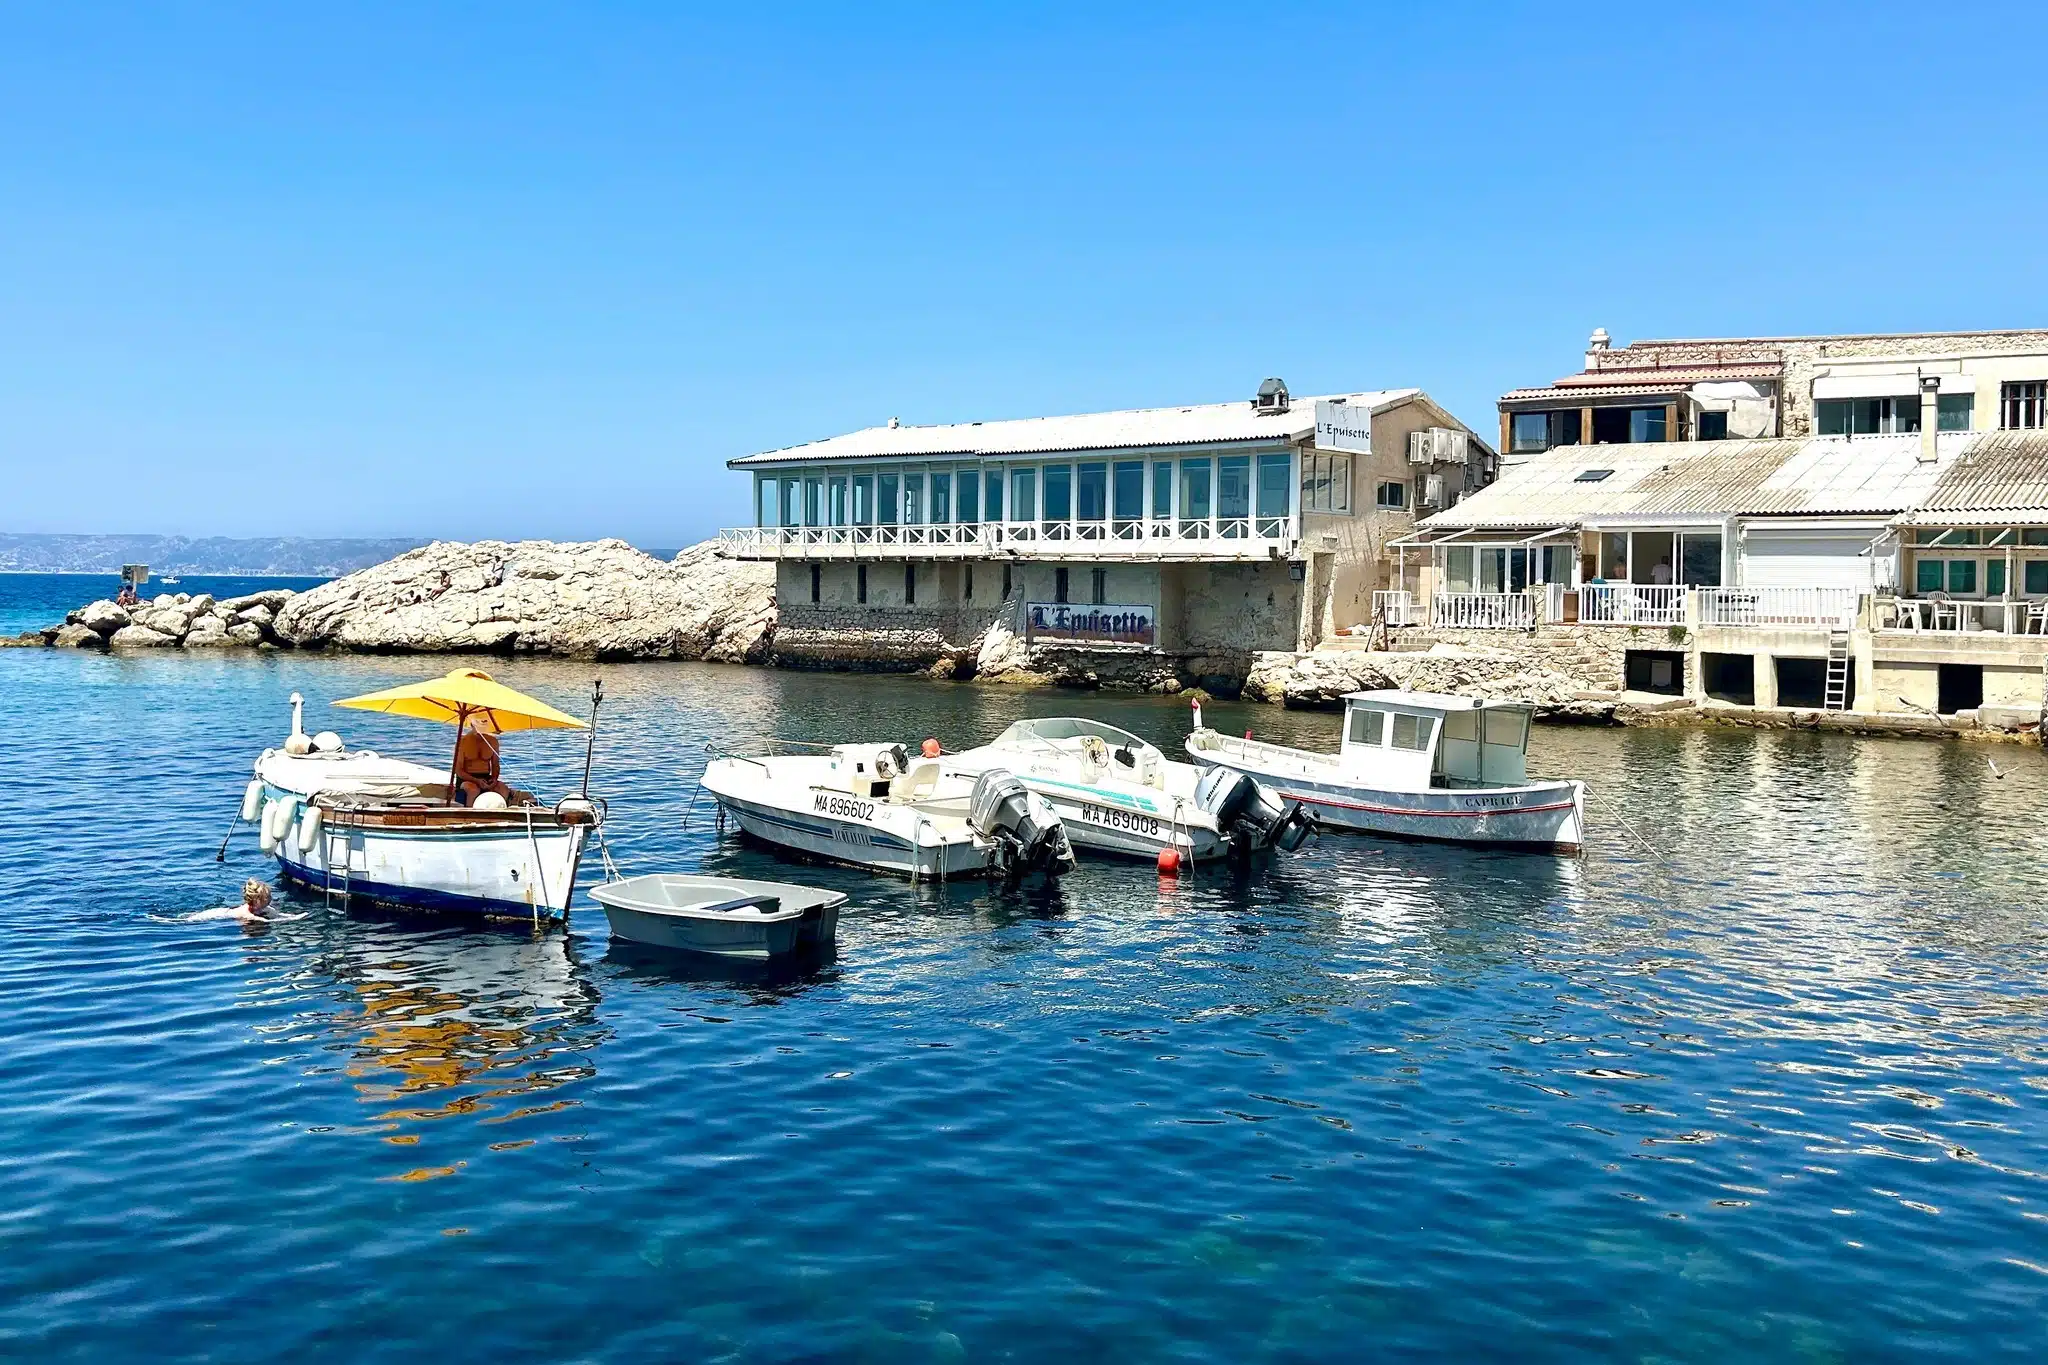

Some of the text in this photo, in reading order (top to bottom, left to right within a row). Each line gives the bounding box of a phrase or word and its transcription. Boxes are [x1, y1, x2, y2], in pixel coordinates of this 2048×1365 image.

[1317, 422, 1370, 446] L'Epuisette
[1032, 605, 1149, 638] L'Epuisette
[814, 794, 828, 812] MA
[829, 797, 874, 821] 896602
[1465, 795, 1523, 807] CAPRICE
